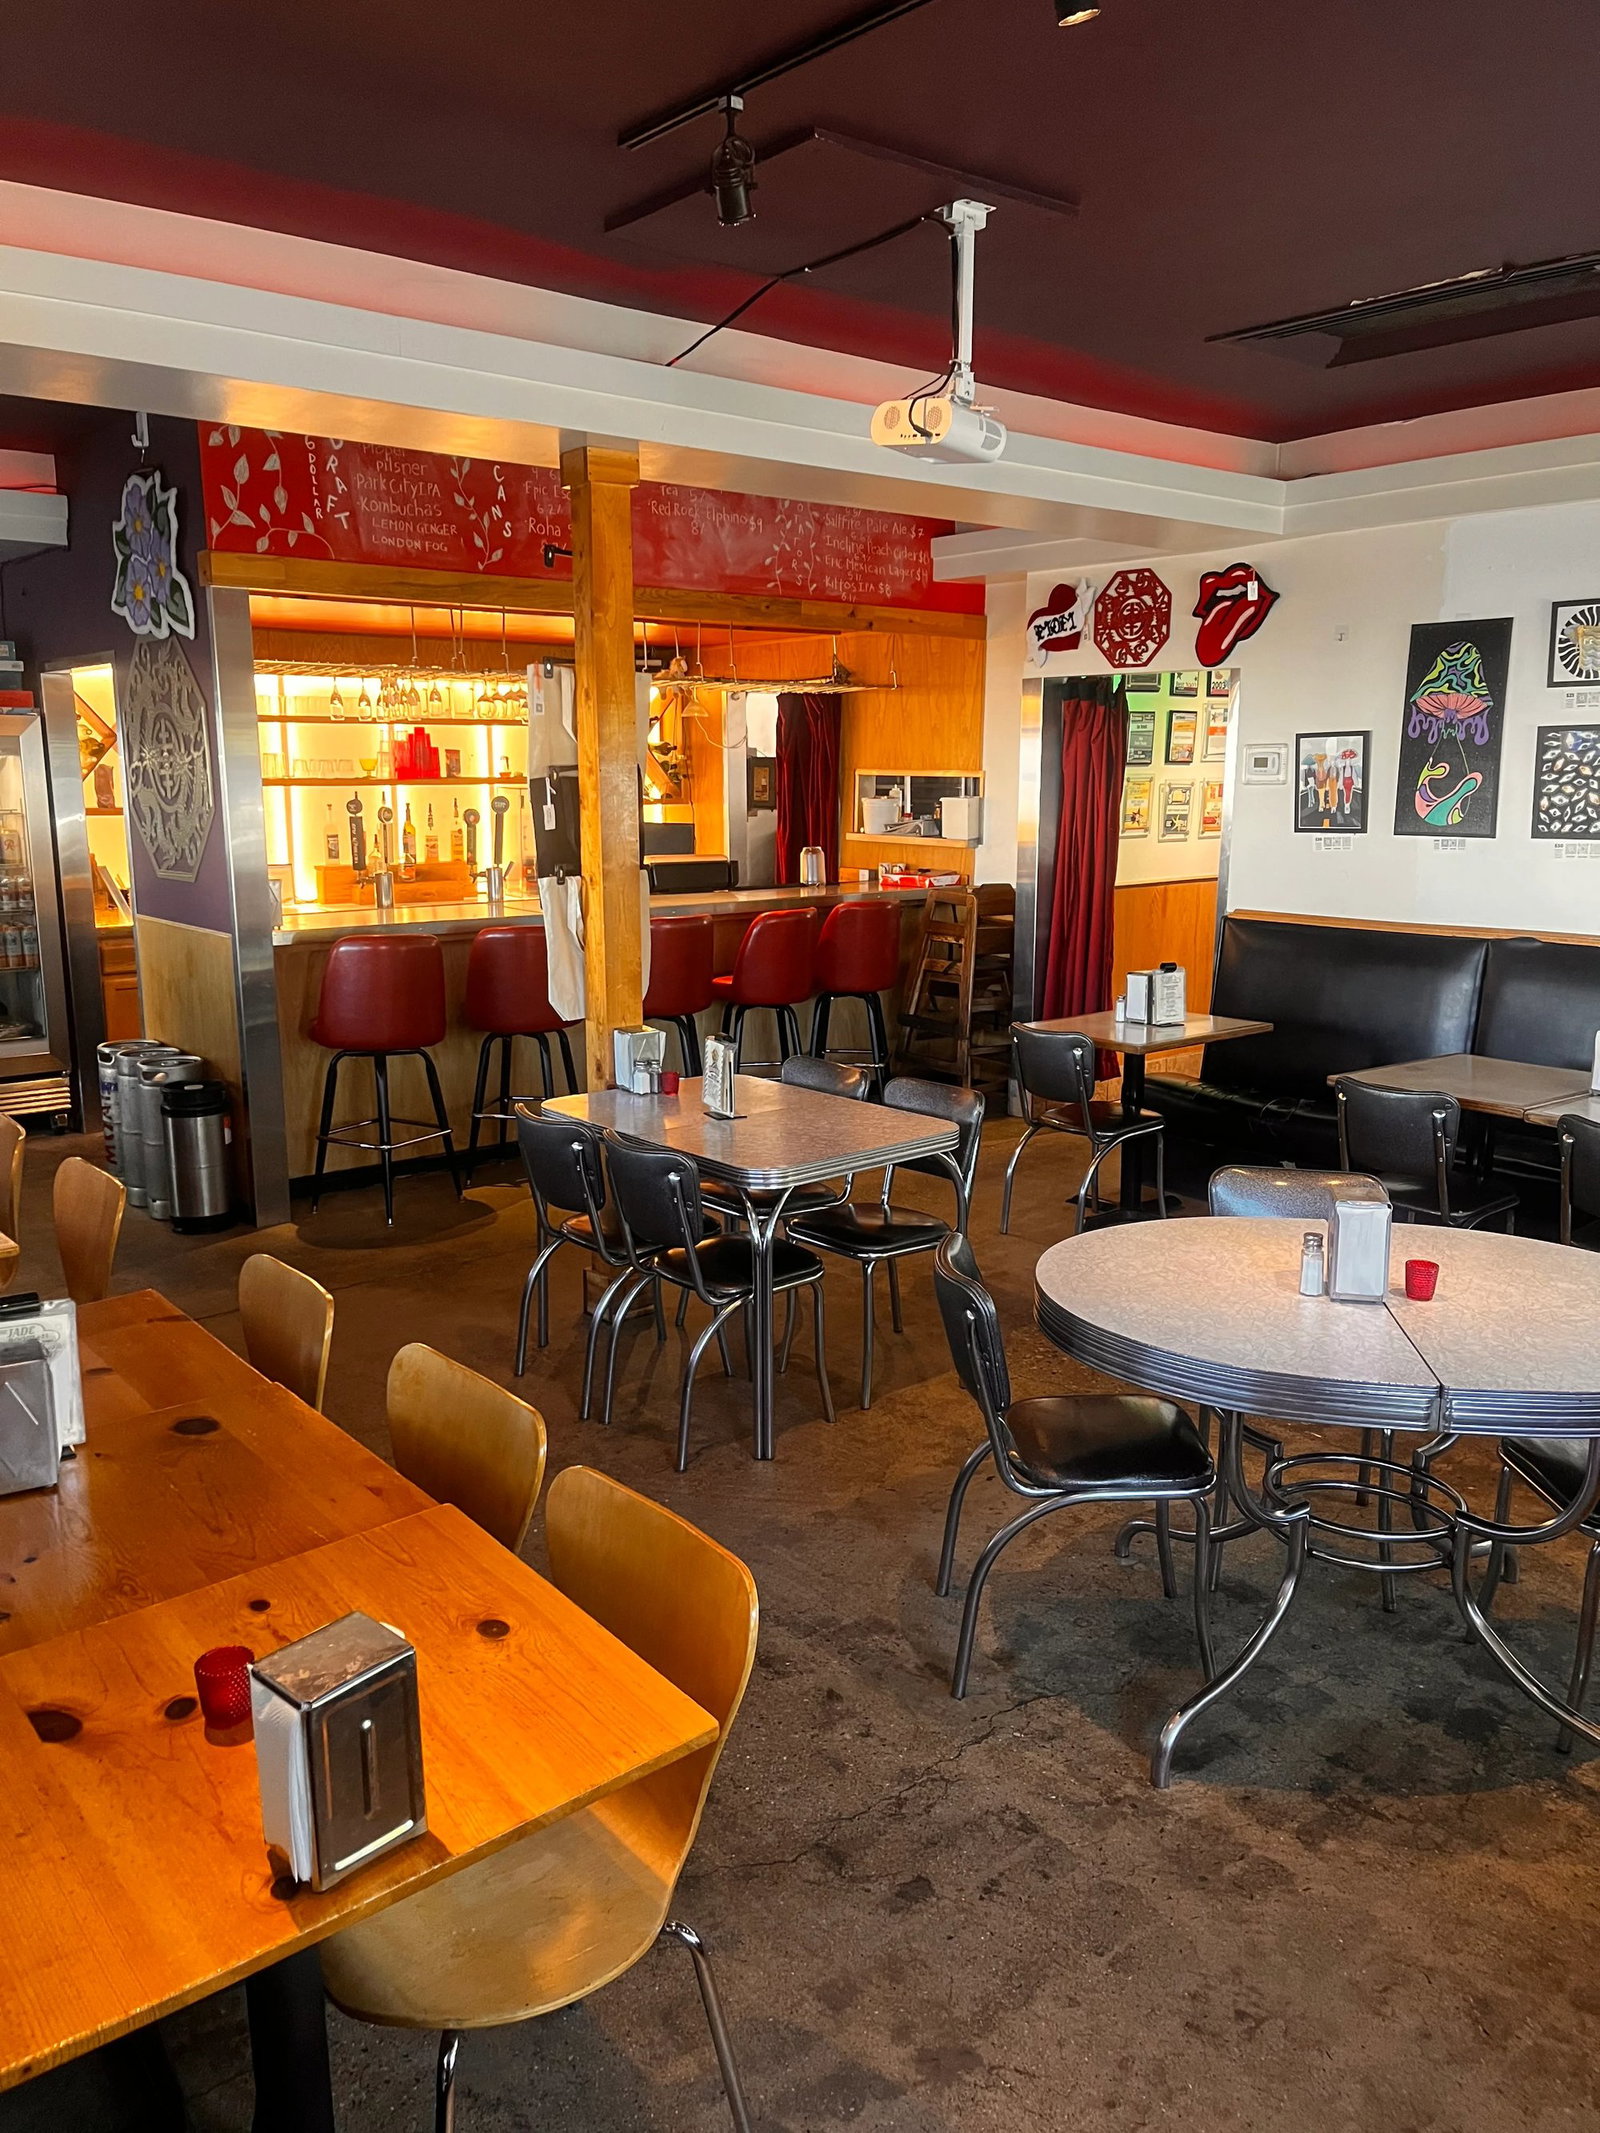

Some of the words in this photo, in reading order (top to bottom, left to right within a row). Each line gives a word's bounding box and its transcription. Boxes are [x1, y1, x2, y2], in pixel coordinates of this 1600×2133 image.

[356, 473, 387, 491] Park
[525, 481, 548, 500] Epic
[361, 496, 442, 516] Kombuchas
[491, 465, 512, 538] CANS
[651, 500, 671, 517] Red
[674, 502, 700, 520] Rock
[372, 518, 413, 533] LEMON
[529, 515, 562, 537] Roha
[892, 522, 908, 536] Ale
[372, 535, 421, 550] LONDON
[425, 541, 448, 552] FOG
